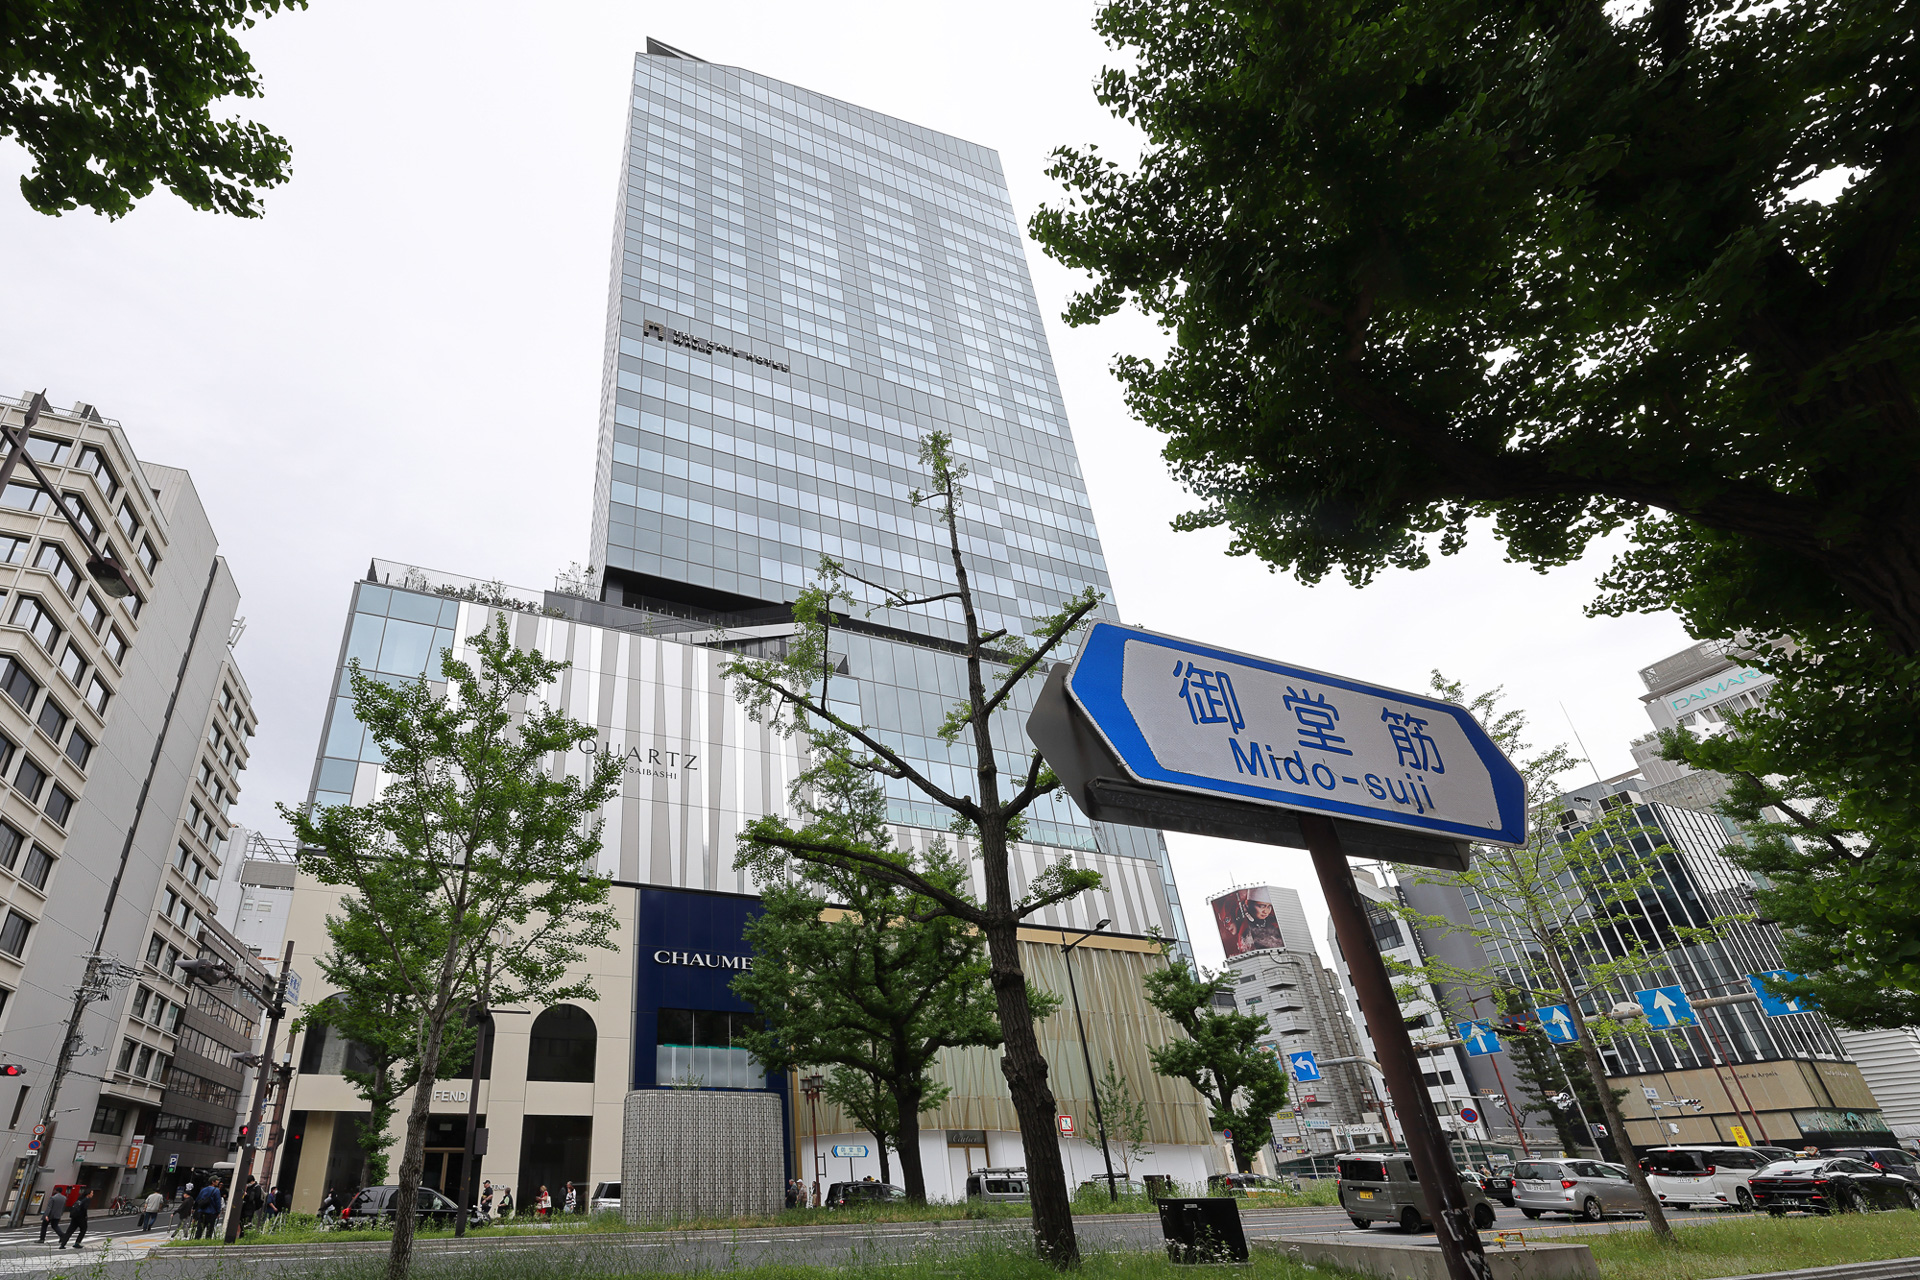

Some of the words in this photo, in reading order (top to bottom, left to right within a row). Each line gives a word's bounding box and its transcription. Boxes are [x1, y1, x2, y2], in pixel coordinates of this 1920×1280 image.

[673, 330, 701, 343] THE
[707, 340, 739, 358] GATE
[746, 353, 790, 373] HOTEL
[1172, 659, 1446, 775] 御堂筋
[578, 738, 698, 770] QUARTZ
[1228, 737, 1435, 816] Mido-suji
[653, 950, 754, 970] CHAUME
[433, 1090, 470, 1103] FENDI
